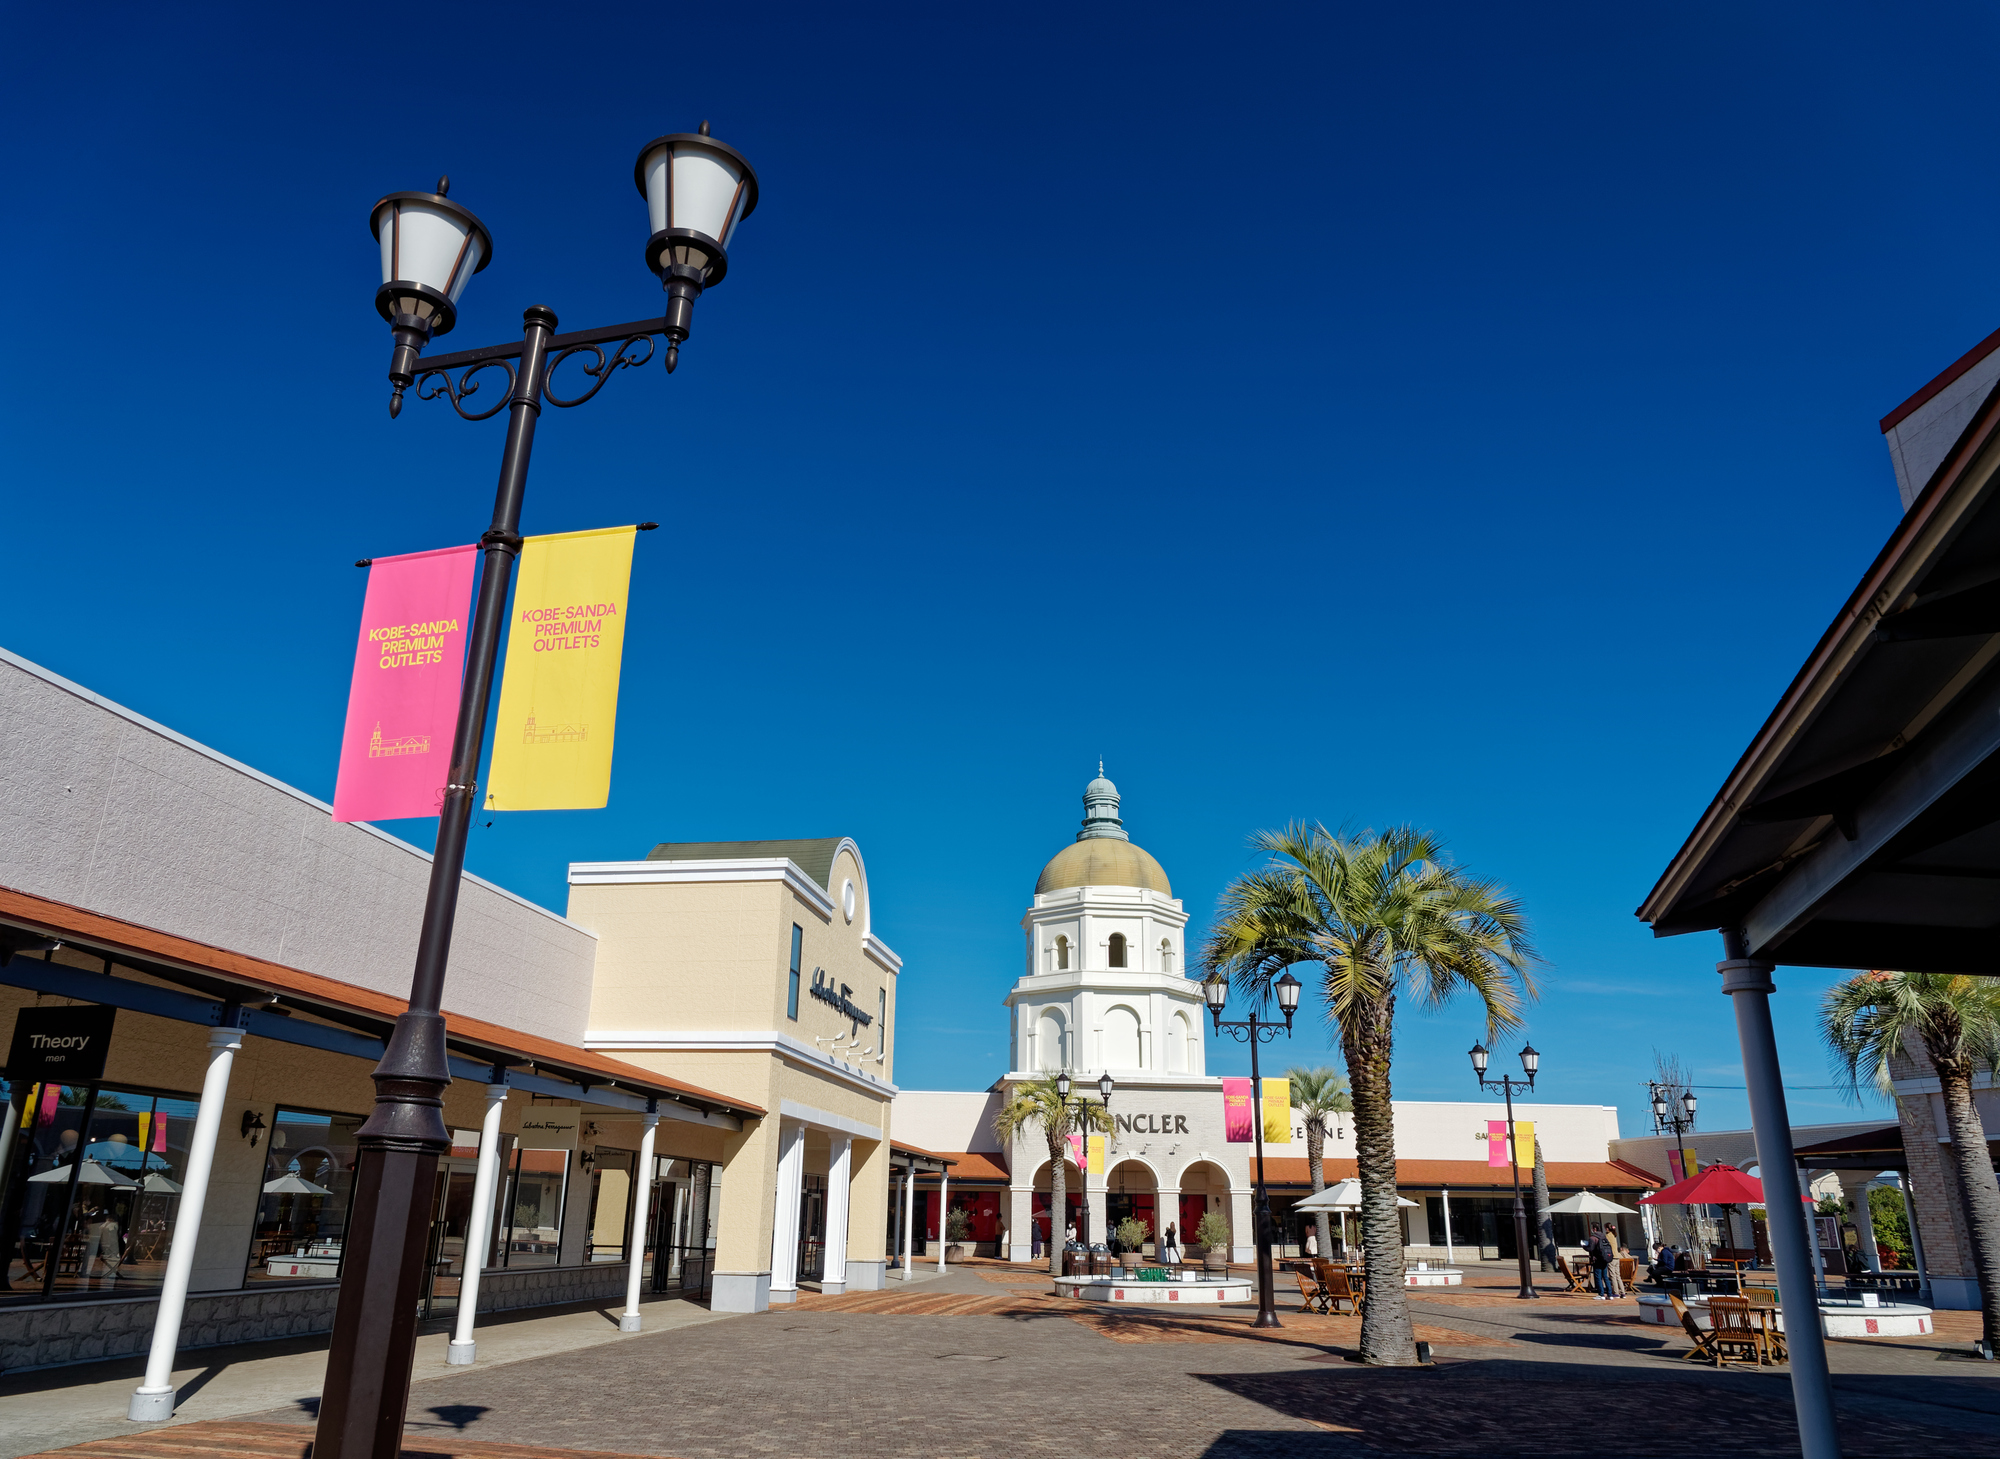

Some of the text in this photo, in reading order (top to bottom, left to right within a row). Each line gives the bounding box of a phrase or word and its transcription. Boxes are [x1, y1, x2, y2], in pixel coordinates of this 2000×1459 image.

[522, 602, 617, 623] KOBE-SANDA
[368, 619, 459, 642] KOBE-SANDA
[534, 619, 602, 637] PREMIUM
[381, 635, 444, 655] PREMIUM
[533, 634, 601, 652] OUTLETS
[379, 650, 443, 669] OUTLETS
[30, 1034, 90, 1051] Theory
